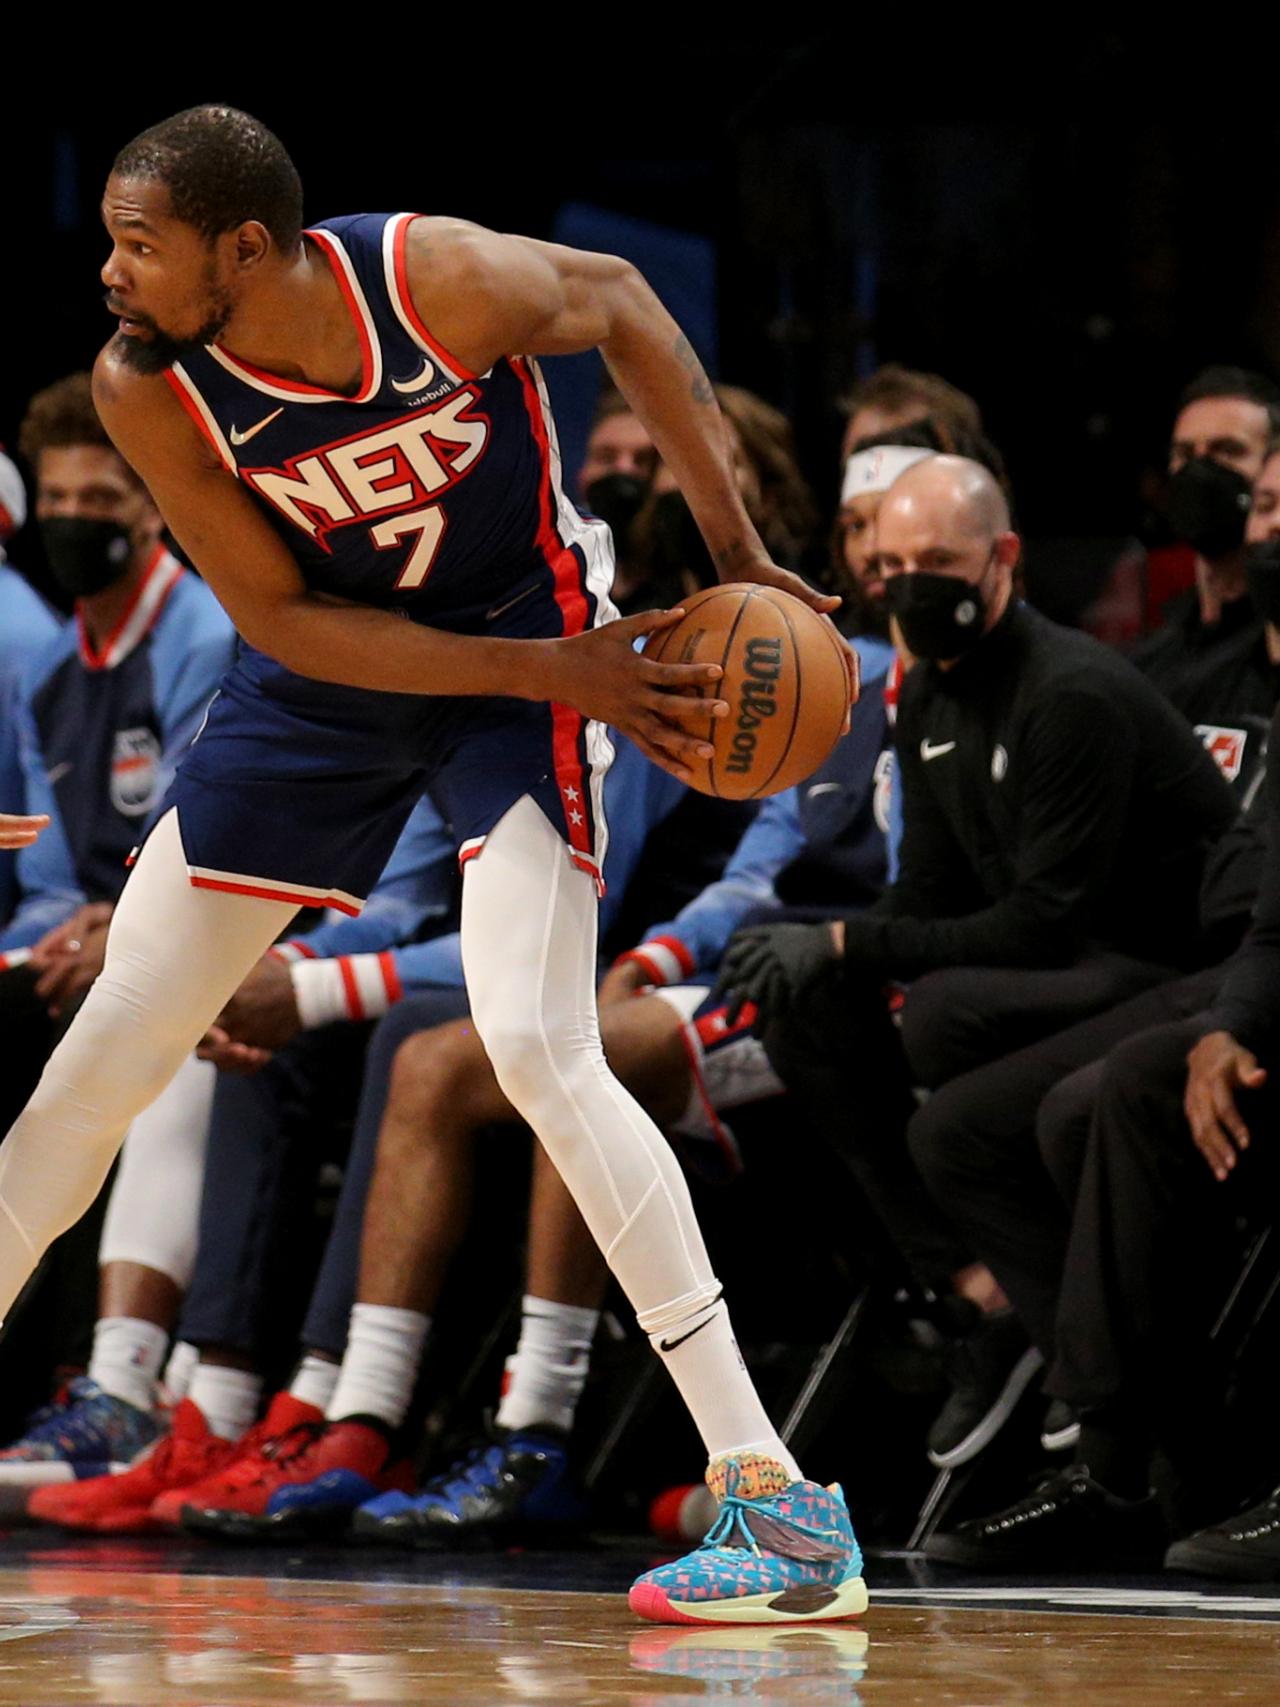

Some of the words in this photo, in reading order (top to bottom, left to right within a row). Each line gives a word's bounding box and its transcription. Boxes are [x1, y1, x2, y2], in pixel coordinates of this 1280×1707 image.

[245, 387, 489, 540] NETS
[371, 505, 445, 589] 7
[726, 637, 783, 774] Wilson
